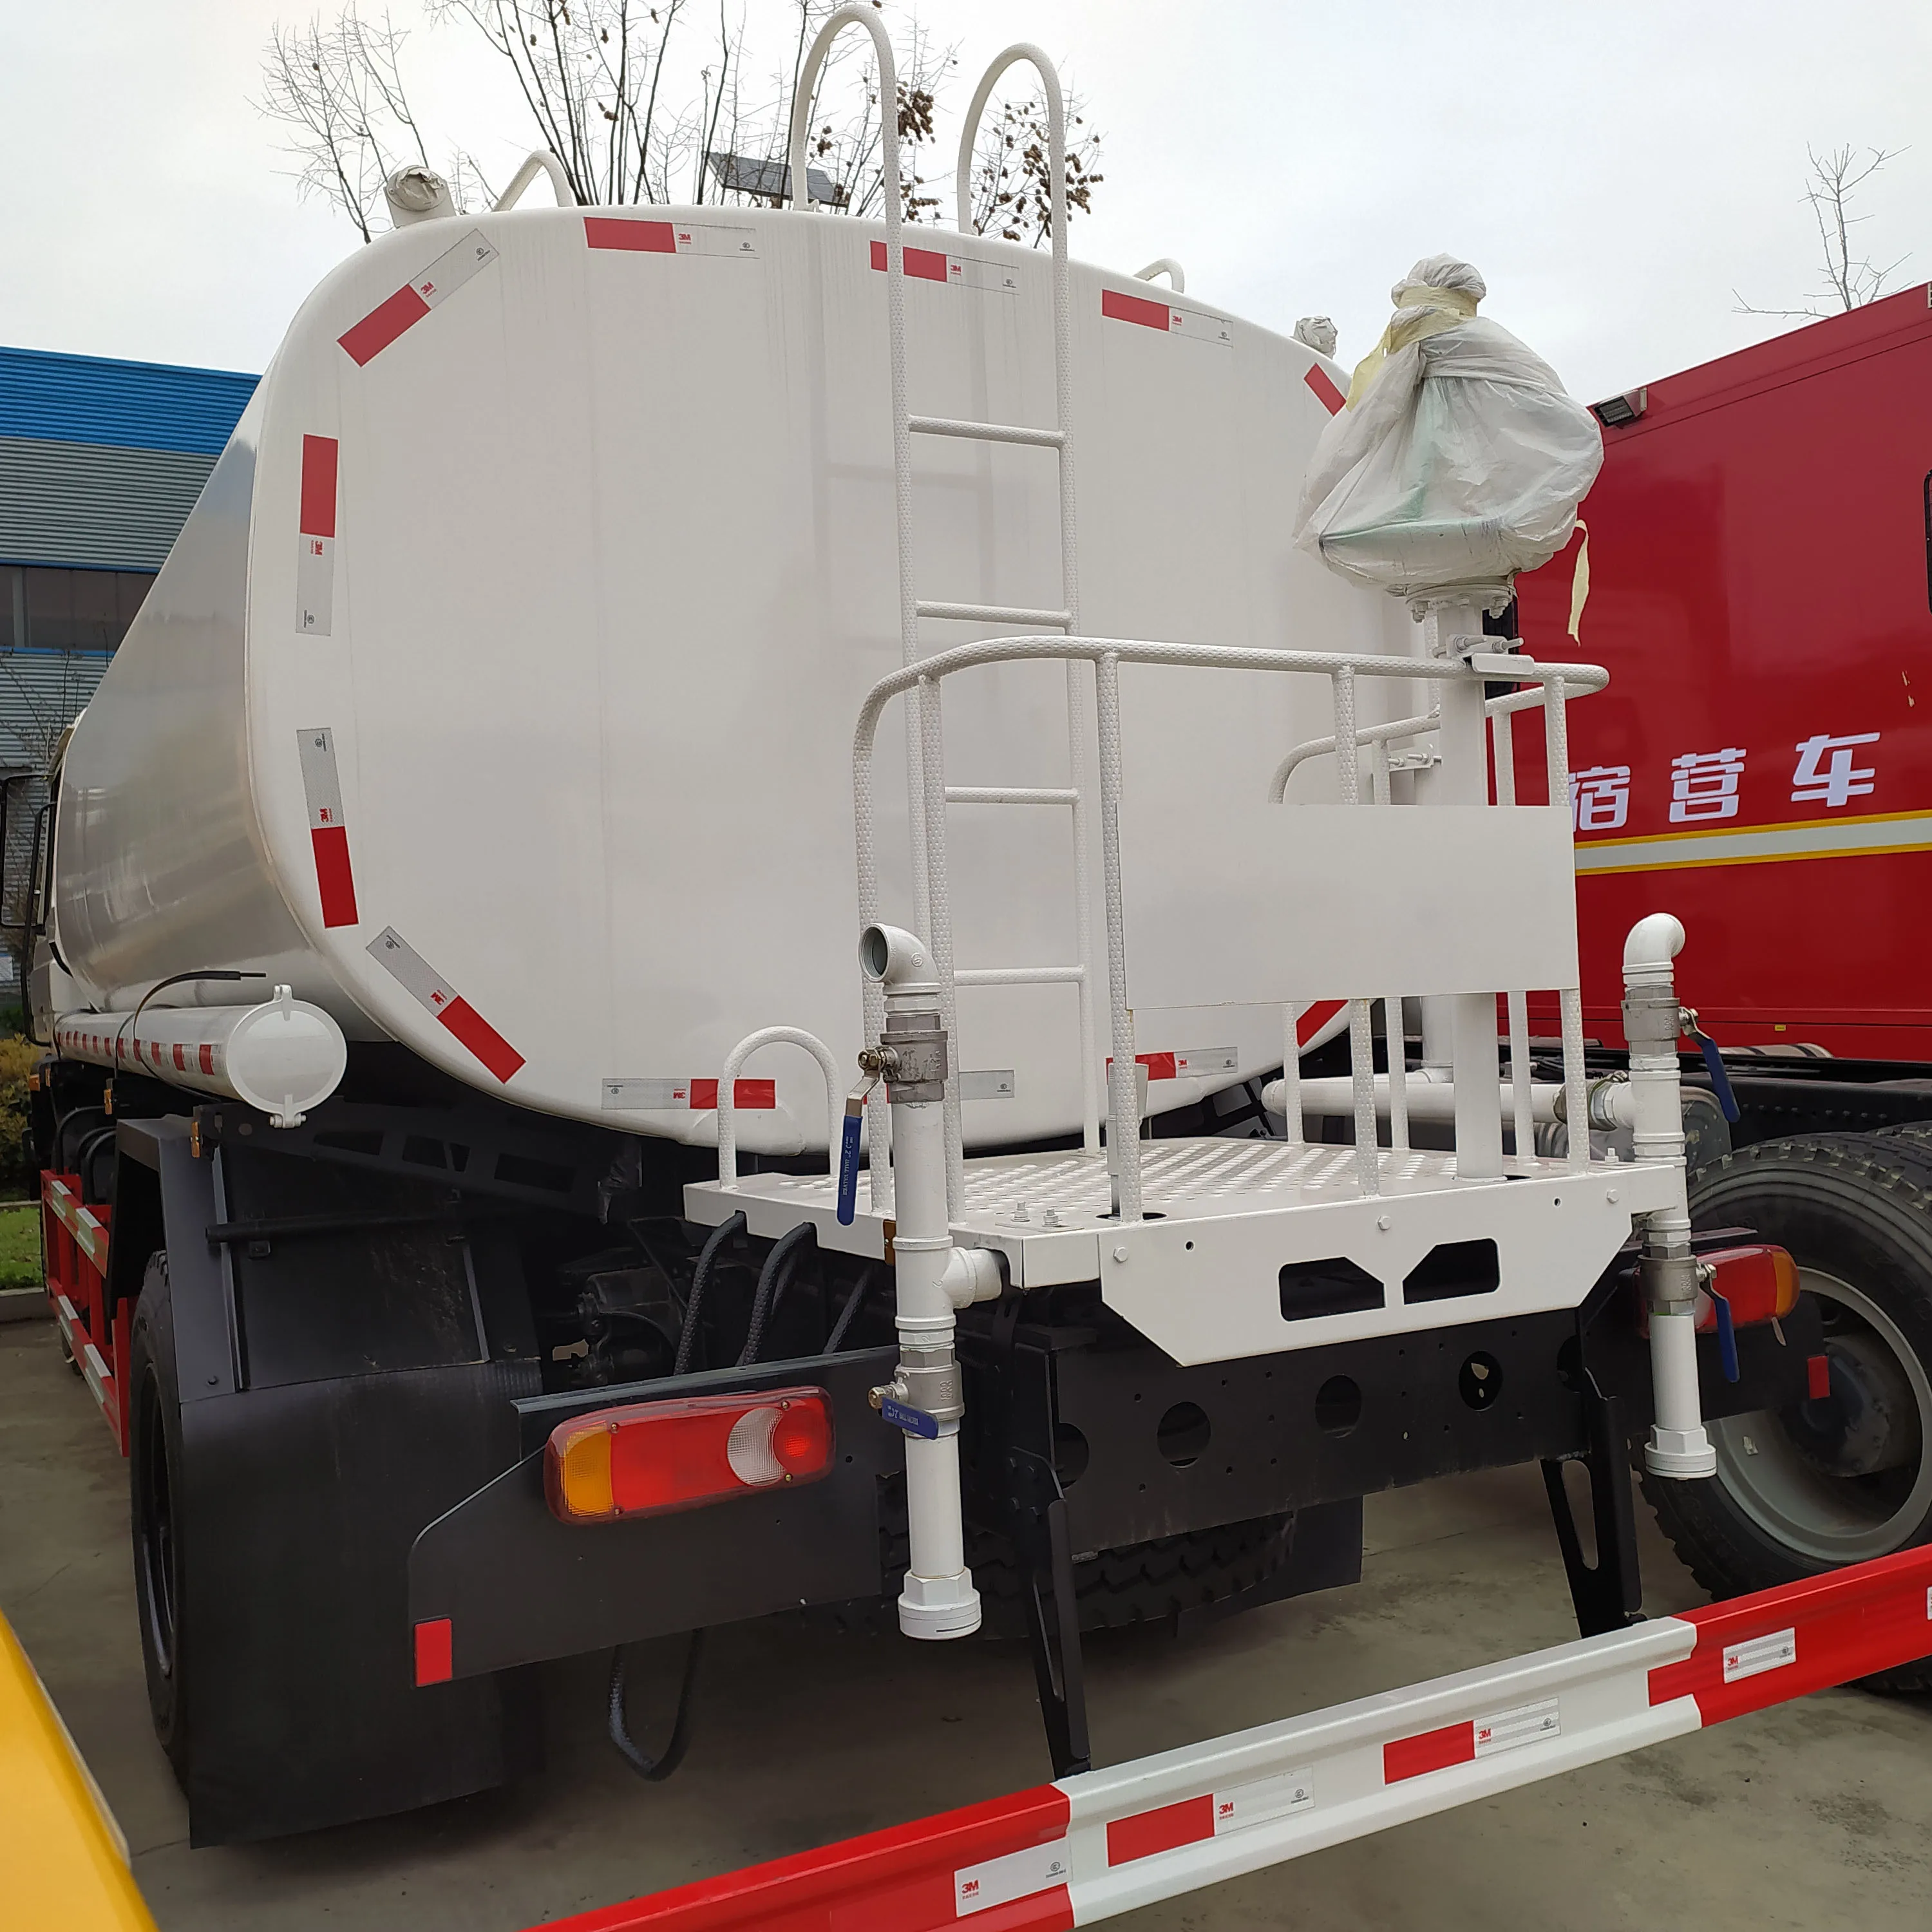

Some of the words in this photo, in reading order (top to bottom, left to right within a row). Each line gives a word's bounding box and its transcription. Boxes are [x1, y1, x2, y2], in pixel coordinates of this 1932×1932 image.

[421, 281, 434, 294] 3M
[315, 540, 323, 555] 3M
[1569, 732, 1880, 833] 宿营车
[319, 808, 328, 822] 3M
[430, 992, 444, 1005] 3M
[1728, 1656, 1739, 1667] 3M
[1479, 1728, 1491, 1739] 3M
[1219, 1801, 1234, 1815] 3M
[961, 1879, 979, 1894] 3M
